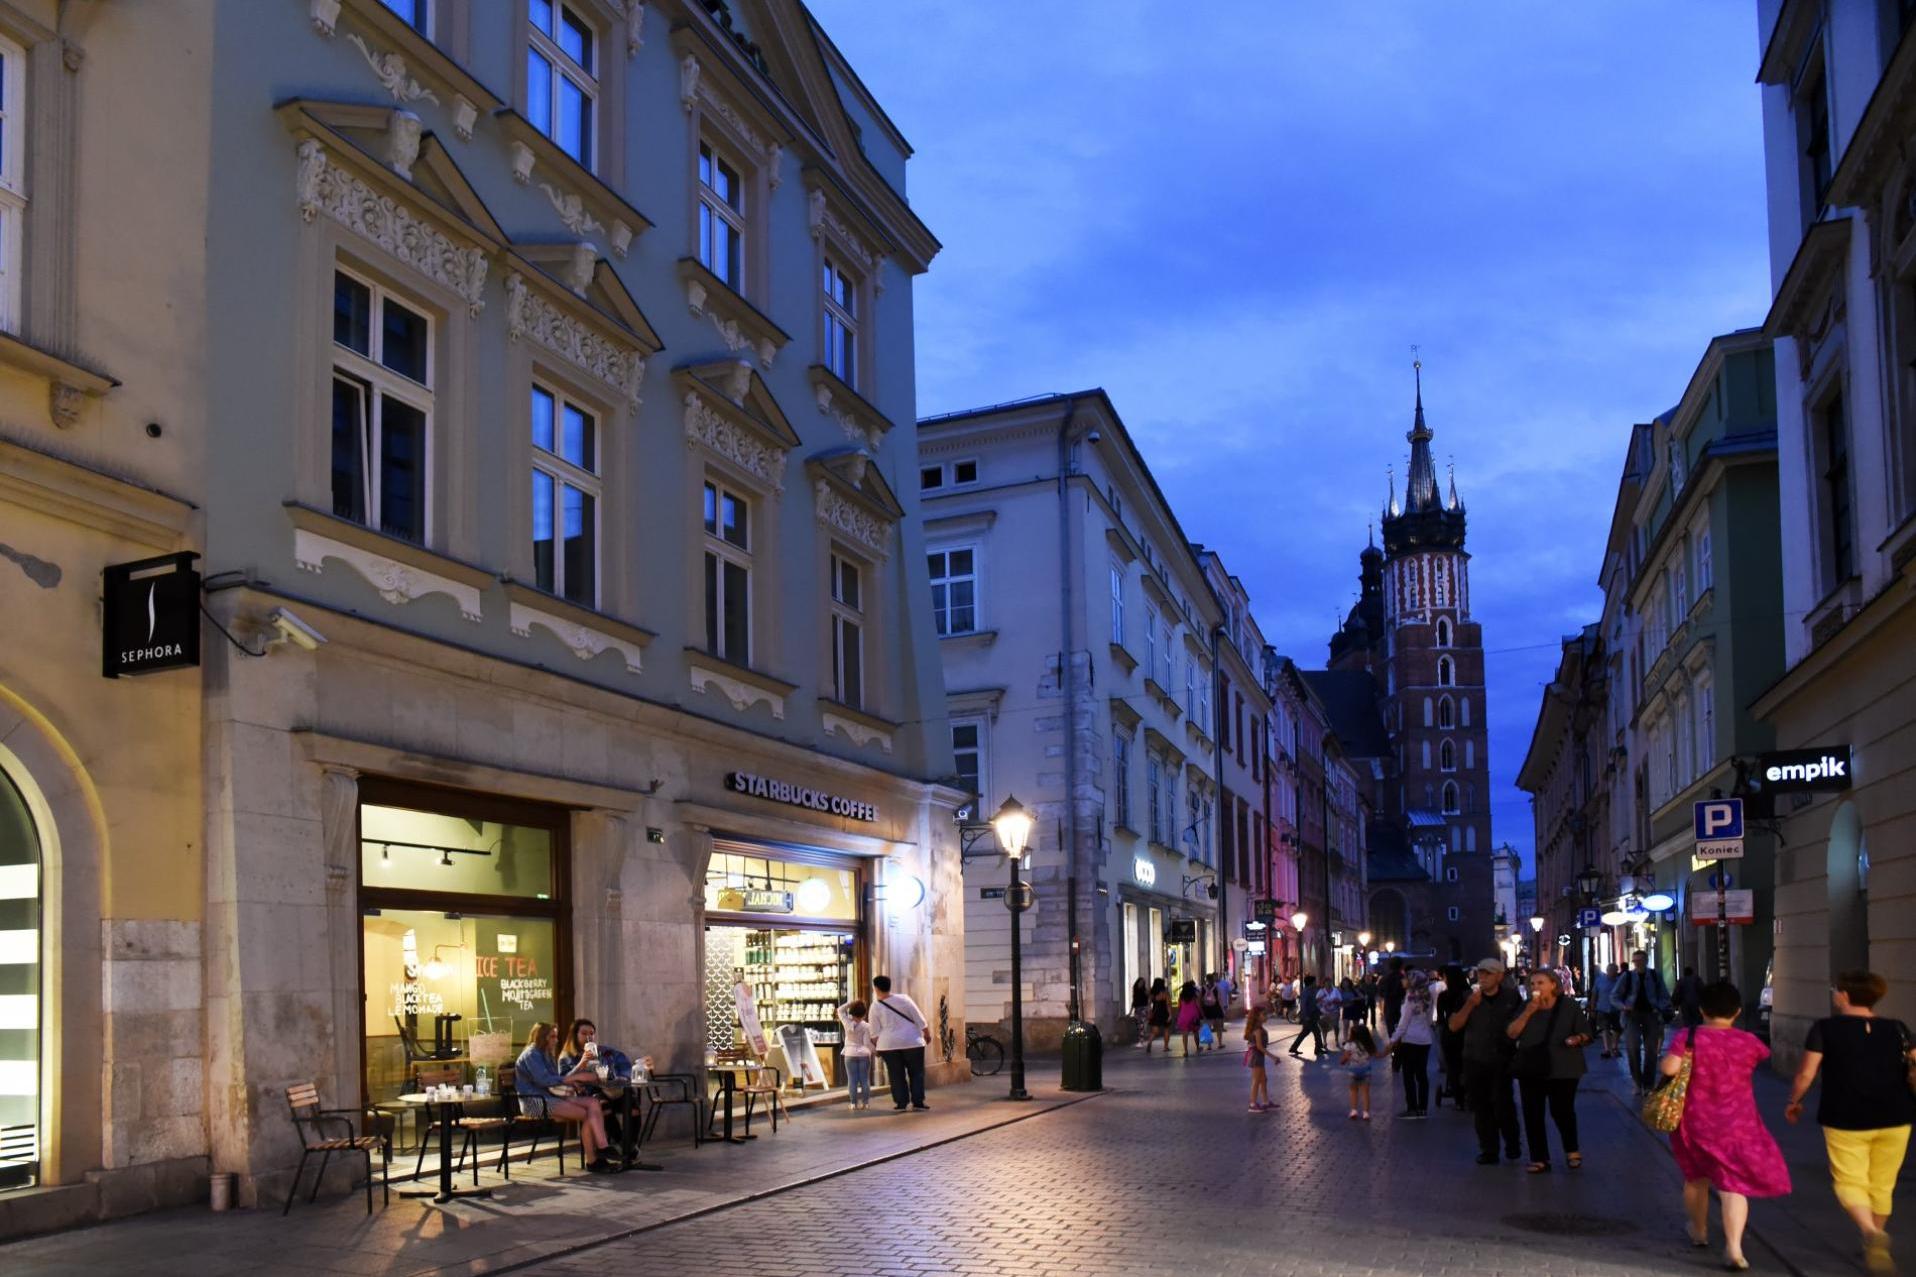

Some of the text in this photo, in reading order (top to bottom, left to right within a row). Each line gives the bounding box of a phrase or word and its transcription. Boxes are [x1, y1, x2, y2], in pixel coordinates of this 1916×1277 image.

[121, 644, 182, 663] SEPHORA
[1766, 756, 1846, 782] empik
[735, 772, 880, 821] STARBUCKS COFFEE
[1704, 804, 1732, 836] P
[1700, 846, 1740, 855] Koniec
[476, 956, 498, 978] ICE
[505, 957, 537, 978] TEA
[500, 978, 547, 989] BLACKBERRY
[520, 1000, 534, 1010] TEA
